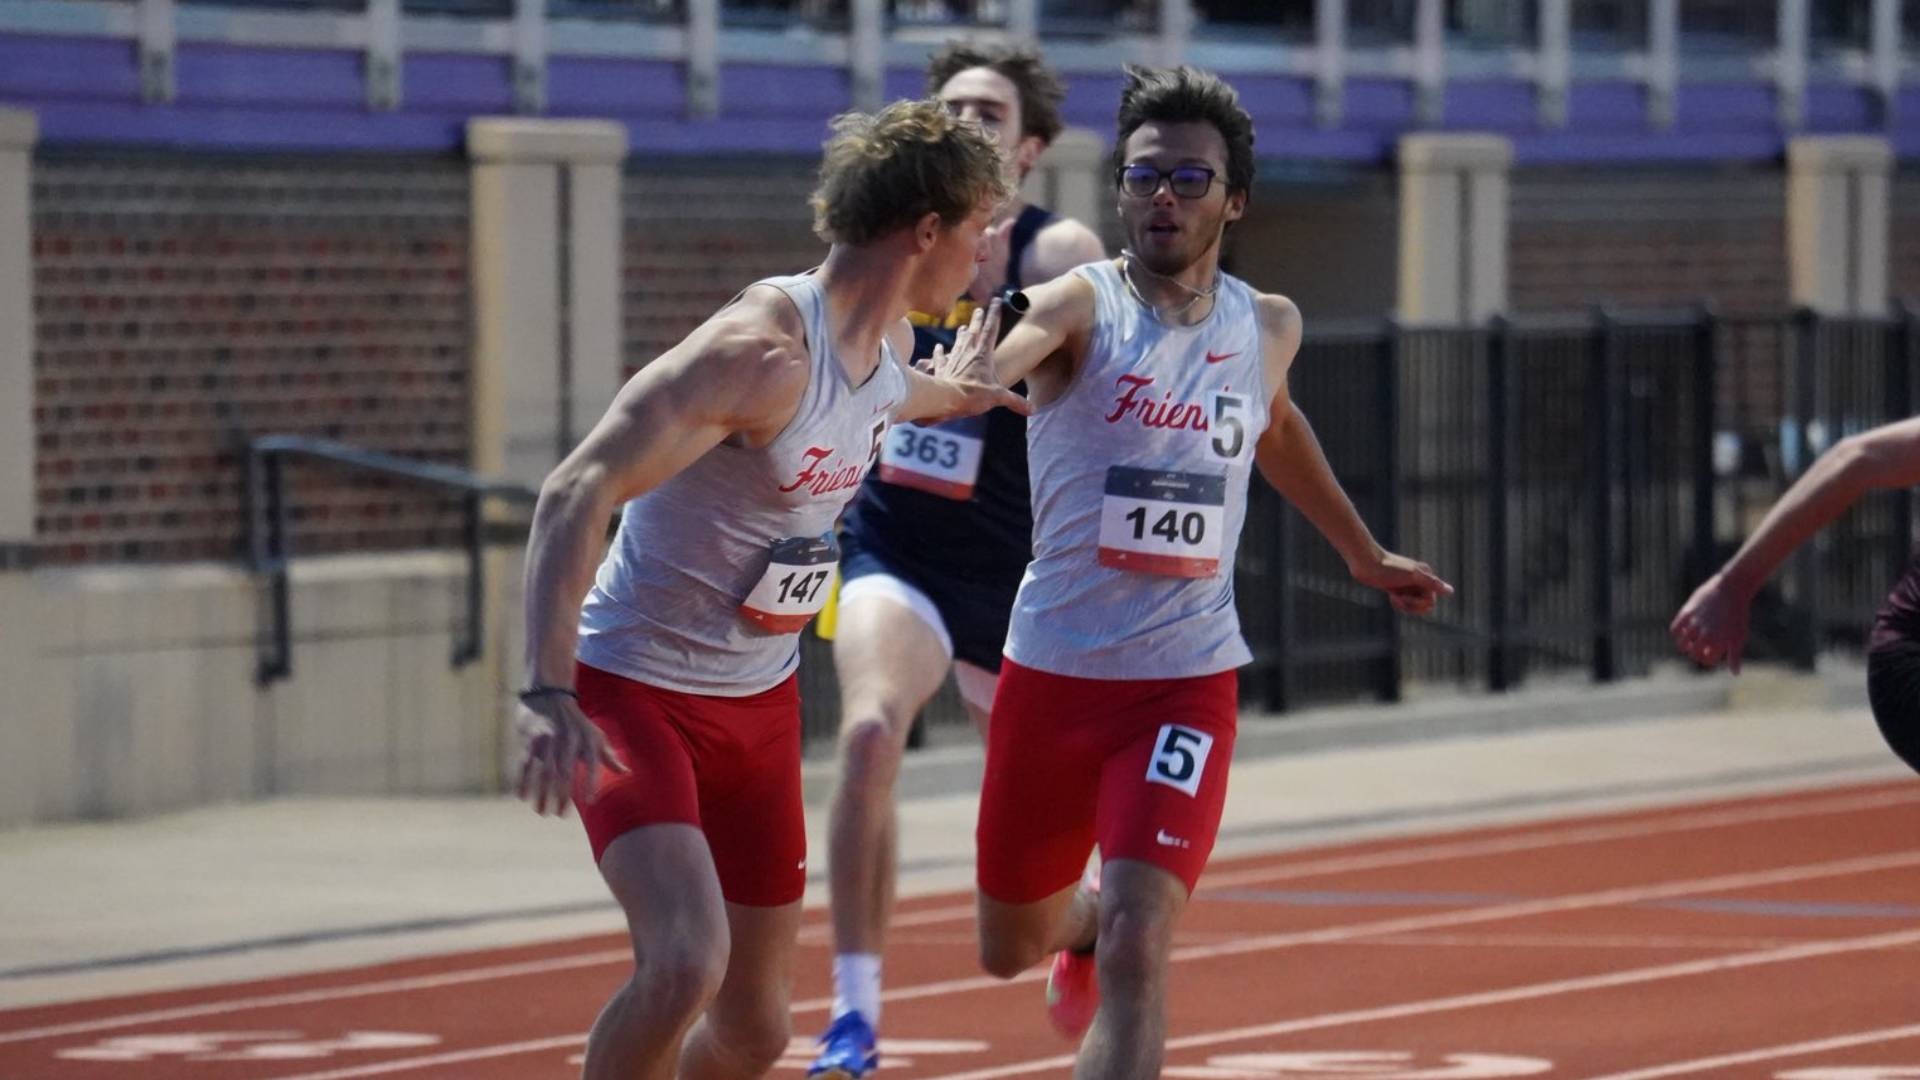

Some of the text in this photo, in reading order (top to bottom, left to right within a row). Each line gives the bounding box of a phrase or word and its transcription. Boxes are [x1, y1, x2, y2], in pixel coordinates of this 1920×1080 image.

[1105, 374, 1229, 432] Frien
[1212, 395, 1244, 459] 5
[779, 446, 866, 496] Frien
[894, 429, 961, 470] 363
[1125, 506, 1206, 546] 140
[777, 570, 829, 604] 147
[1156, 727, 1202, 783] 5
